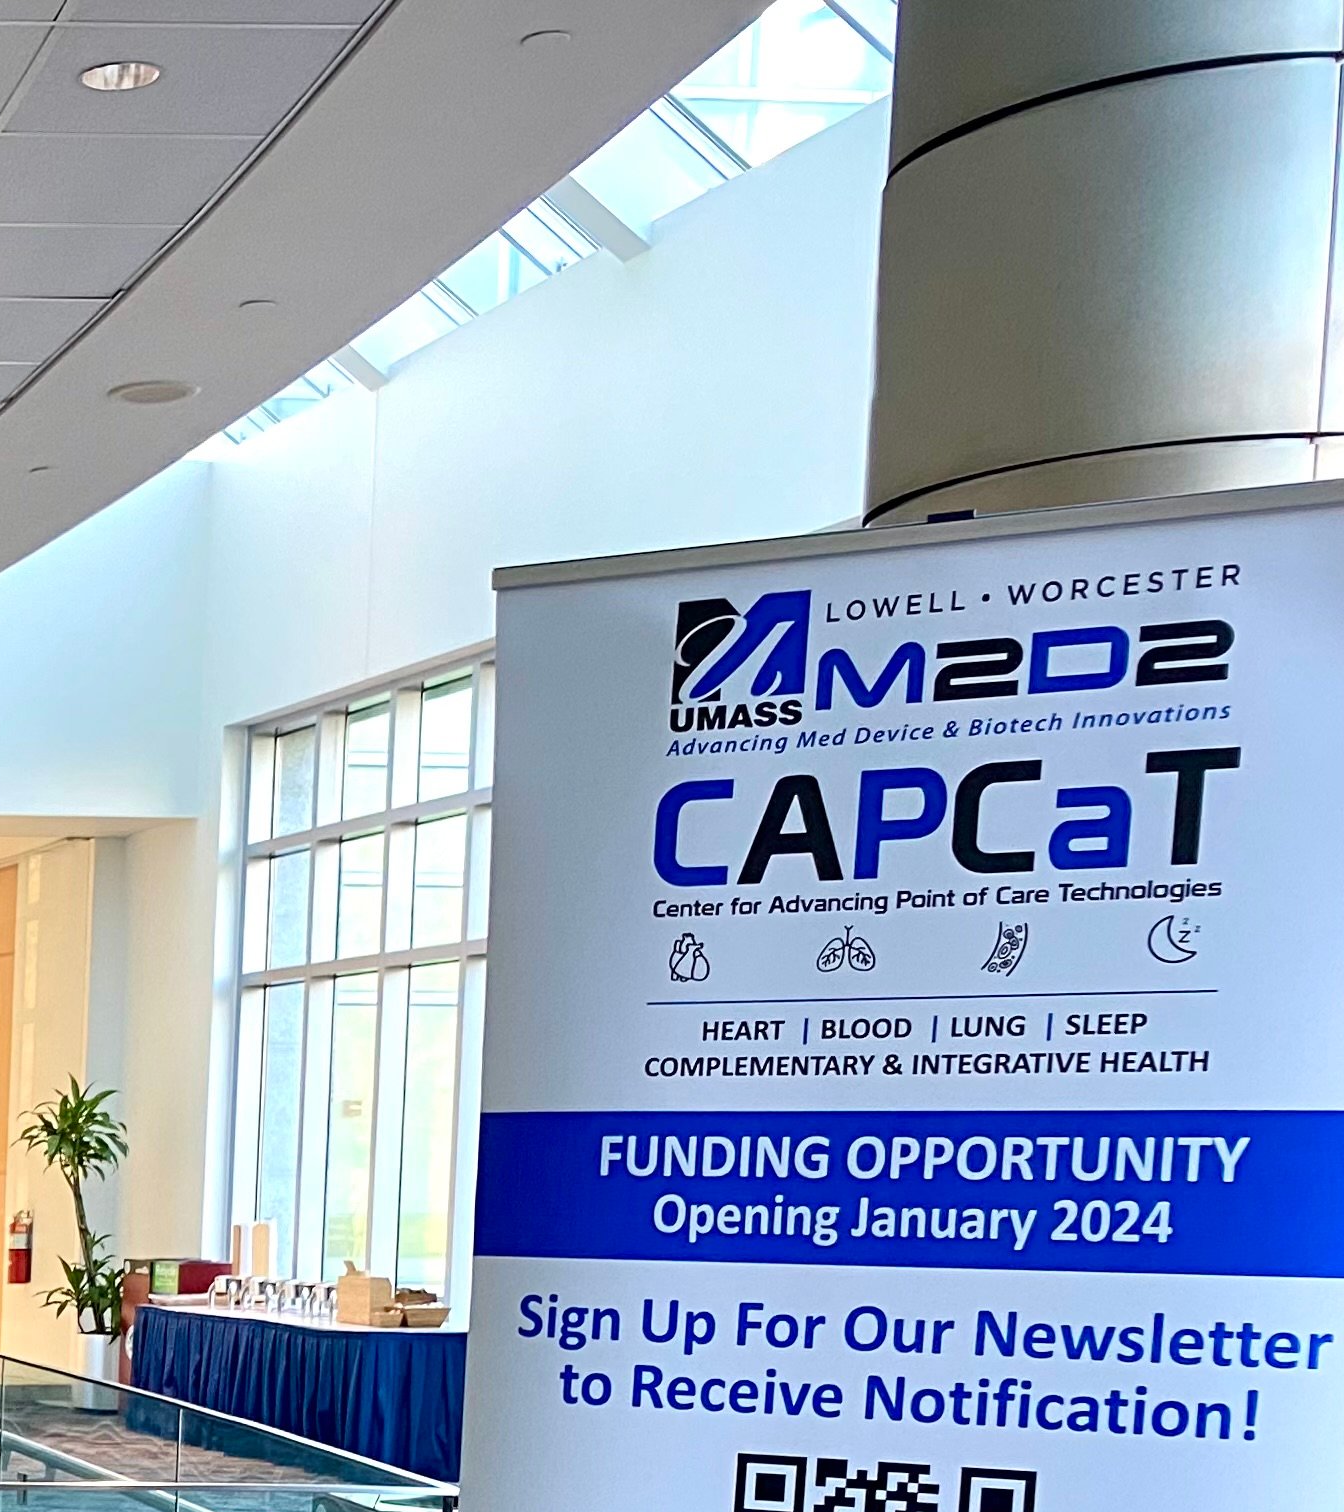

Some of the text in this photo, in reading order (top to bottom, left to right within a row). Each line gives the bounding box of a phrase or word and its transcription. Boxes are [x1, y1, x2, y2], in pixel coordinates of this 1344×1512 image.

[826, 564, 1240, 622] LOWELL WORCESTER
[815, 620, 1234, 711] M2D2
[665, 704, 1230, 756] Advancing Med Device & Biotech Innovations
[669, 699, 802, 732] UMASS
[654, 746, 1241, 887] CAPCaT
[653, 878, 1222, 918] Center for Advancing Point of Care Technologies
[702, 1013, 1147, 1041] HEART BLOOD LUNG SLEEP
[644, 1050, 1209, 1077] COMPLEMENTARY & INTEGRATIVE HEALTH
[601, 1135, 1250, 1183] FUNDING OPPORTUNITY
[654, 1194, 1173, 1251] Opening January 2024
[518, 1294, 1333, 1369] Sign Up For Our Newsletter
[559, 1364, 1259, 1441] to Receive Notification!
